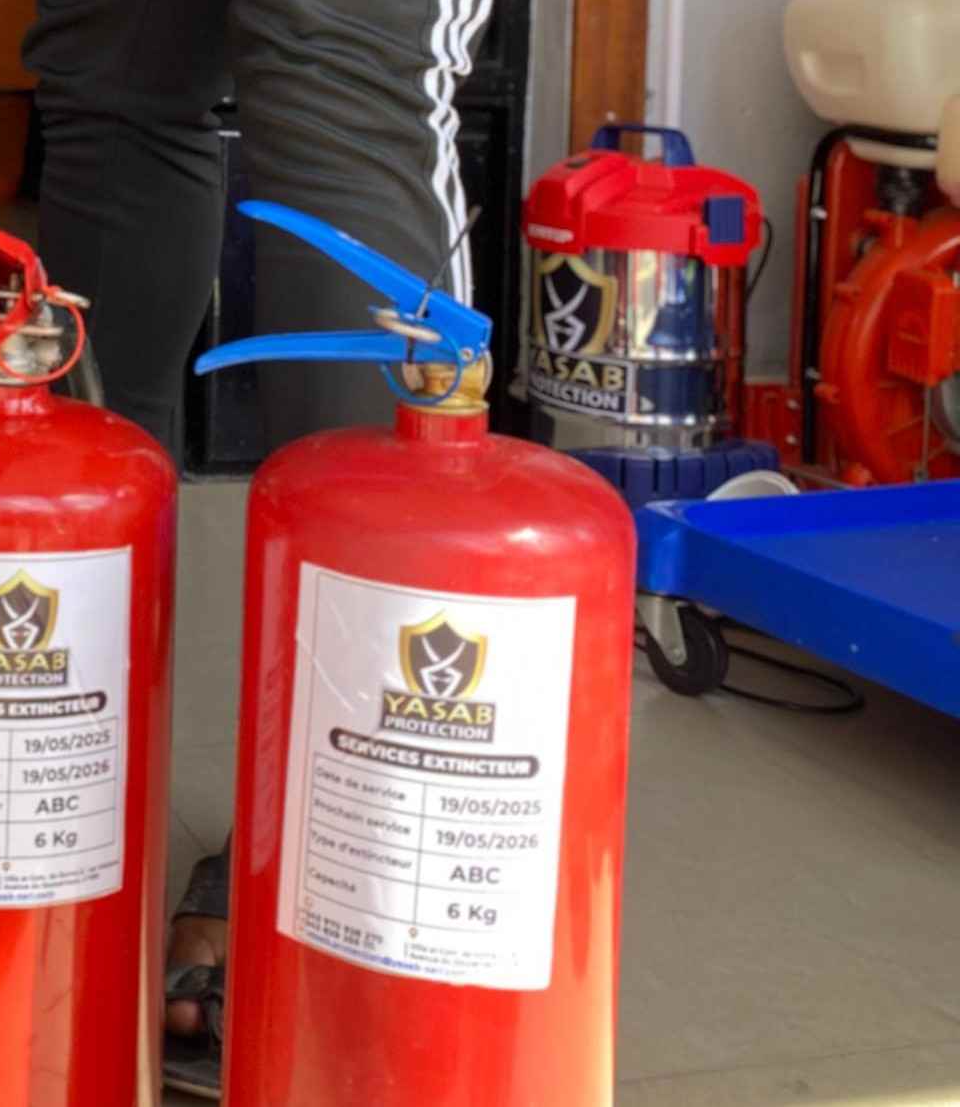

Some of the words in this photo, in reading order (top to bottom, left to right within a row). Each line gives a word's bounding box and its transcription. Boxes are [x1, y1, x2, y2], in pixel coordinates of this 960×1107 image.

[7, 696, 101, 717] EXTINCTEUR
[383, 694, 494, 725] YASAB
[383, 714, 490, 741] PROTECTION
[24, 729, 111, 754] 19/05/2025
[337, 735, 421, 766] SERVICES
[422, 753, 532, 777] EXTINCTEUR
[22, 759, 110, 785] 19/05/2026
[35, 795, 80, 815] ABC
[439, 795, 543, 816] 19/05/2025
[34, 832, 47, 849] 6
[52, 829, 79, 849] Kg
[436, 828, 540, 850] 19/05/2026
[449, 865, 501, 885] ABC
[446, 902, 461, 920] 6
[468, 904, 498, 926] Kg
